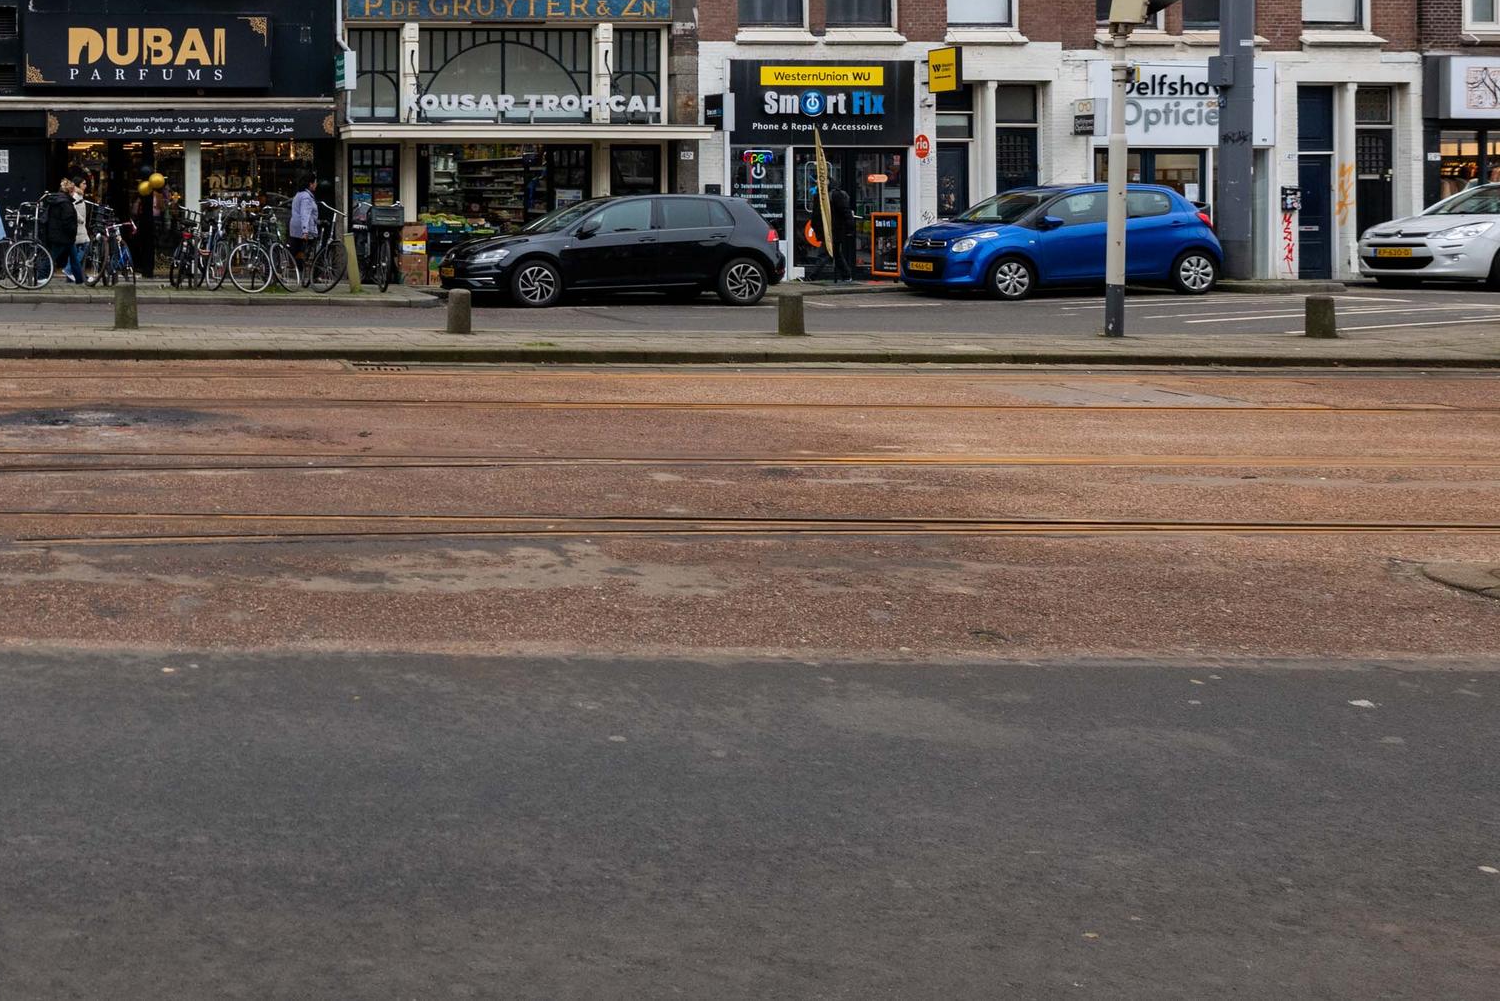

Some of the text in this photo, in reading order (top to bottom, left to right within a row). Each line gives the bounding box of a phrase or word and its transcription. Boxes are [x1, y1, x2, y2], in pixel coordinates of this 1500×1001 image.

[596, 0, 612, 16] &
[68, 27, 226, 66] DUBAI
[70, 69, 223, 81] PARFUMS
[852, 72, 871, 81] WU
[1126, 75, 1220, 96] elfsha
[404, 94, 661, 113] KOUSAR TROPICAL
[1124, 100, 1220, 133] Opticie
[752, 122, 779, 131] Phone
[791, 122, 818, 132] Repai
[831, 122, 883, 131] Accessoires
[916, 137, 928, 148] ria
